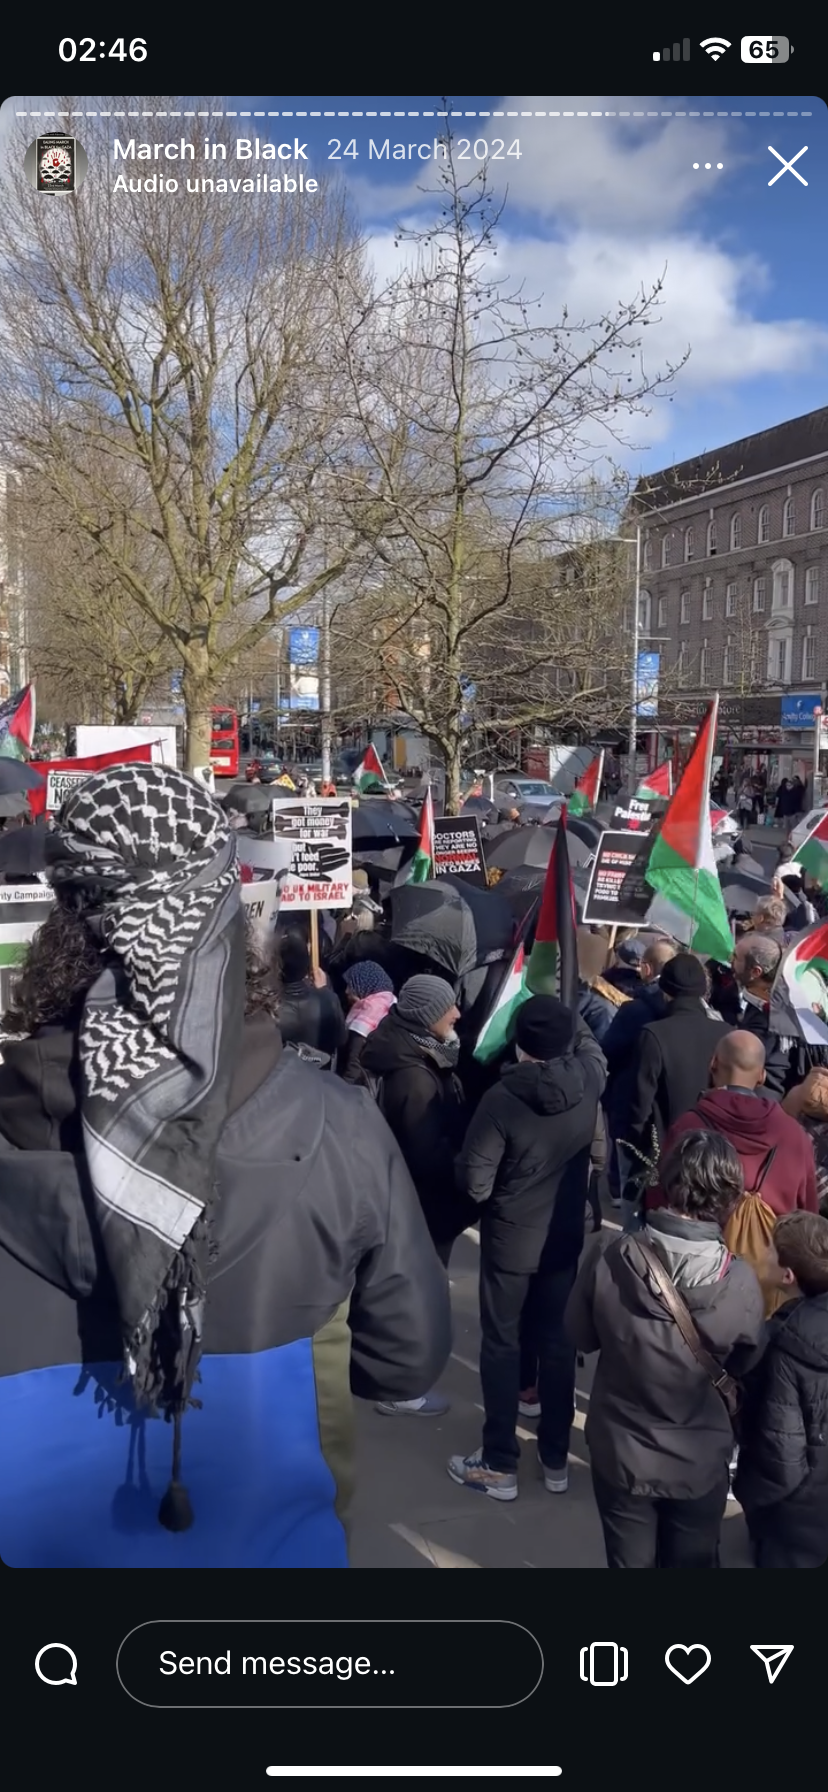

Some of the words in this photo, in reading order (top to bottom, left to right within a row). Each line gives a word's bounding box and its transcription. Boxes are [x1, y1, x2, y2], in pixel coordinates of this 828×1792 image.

[303, 805, 322, 817] They
[291, 819, 305, 829] got
[306, 818, 334, 828] money
[300, 829, 311, 839] for
[313, 829, 329, 839] war
[301, 852, 319, 863] feed
[436, 865, 447, 874] IN
[449, 863, 481, 873] GAZA
[293, 884, 305, 894] UK
[307, 882, 349, 893] MILITARY
[299, 893, 310, 902] TO
[314, 892, 346, 901] ISRAEL
